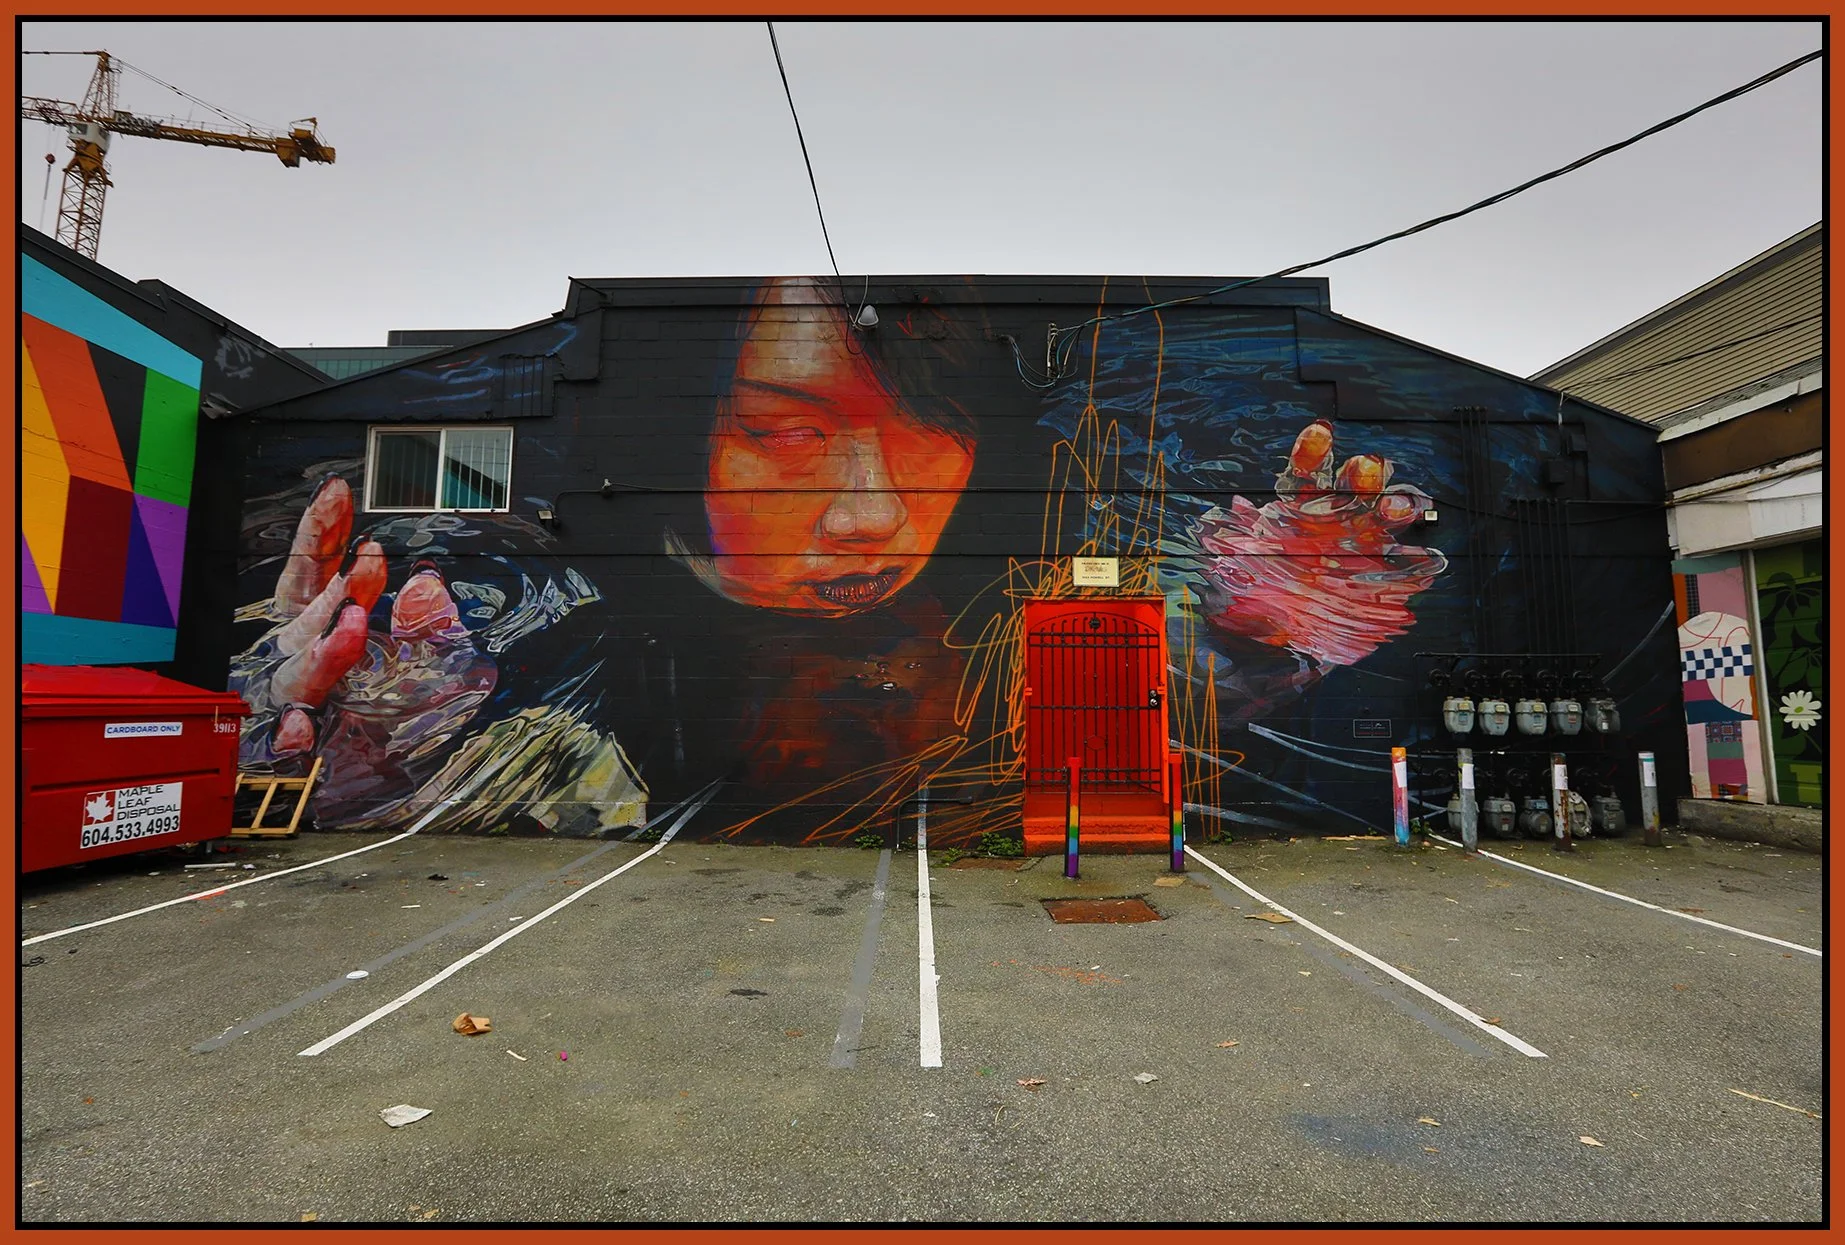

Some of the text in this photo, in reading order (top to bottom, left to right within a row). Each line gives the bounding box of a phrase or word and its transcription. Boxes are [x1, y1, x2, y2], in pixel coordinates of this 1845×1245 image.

[107, 726, 159, 734] CARDBOARD
[213, 723, 236, 733] 39113
[118, 784, 164, 798] MAPLE
[118, 797, 152, 809] LEAF
[117, 804, 180, 820] DISPOSAL
[82, 815, 179, 847] 604.533.4993
